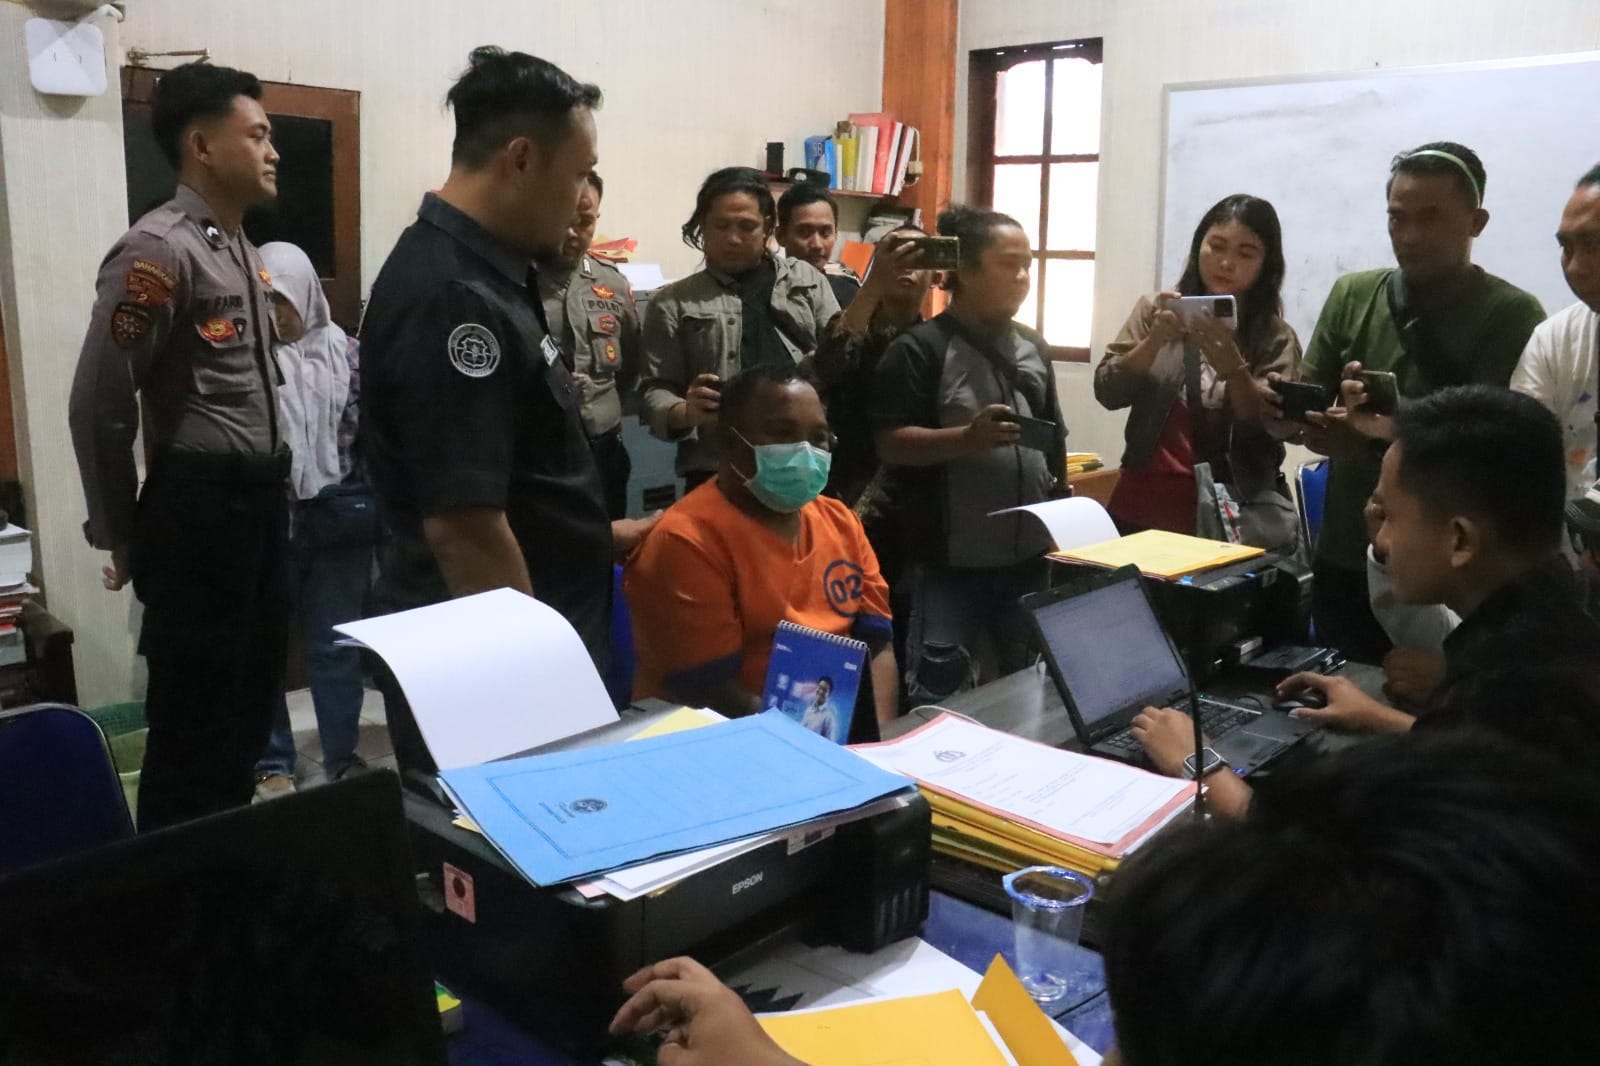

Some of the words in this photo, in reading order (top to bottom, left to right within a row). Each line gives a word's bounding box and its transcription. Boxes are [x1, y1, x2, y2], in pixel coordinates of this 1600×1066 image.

[587, 299, 621, 314] POLRI
[831, 574, 863, 604] 02
[731, 871, 764, 896] EPSON
